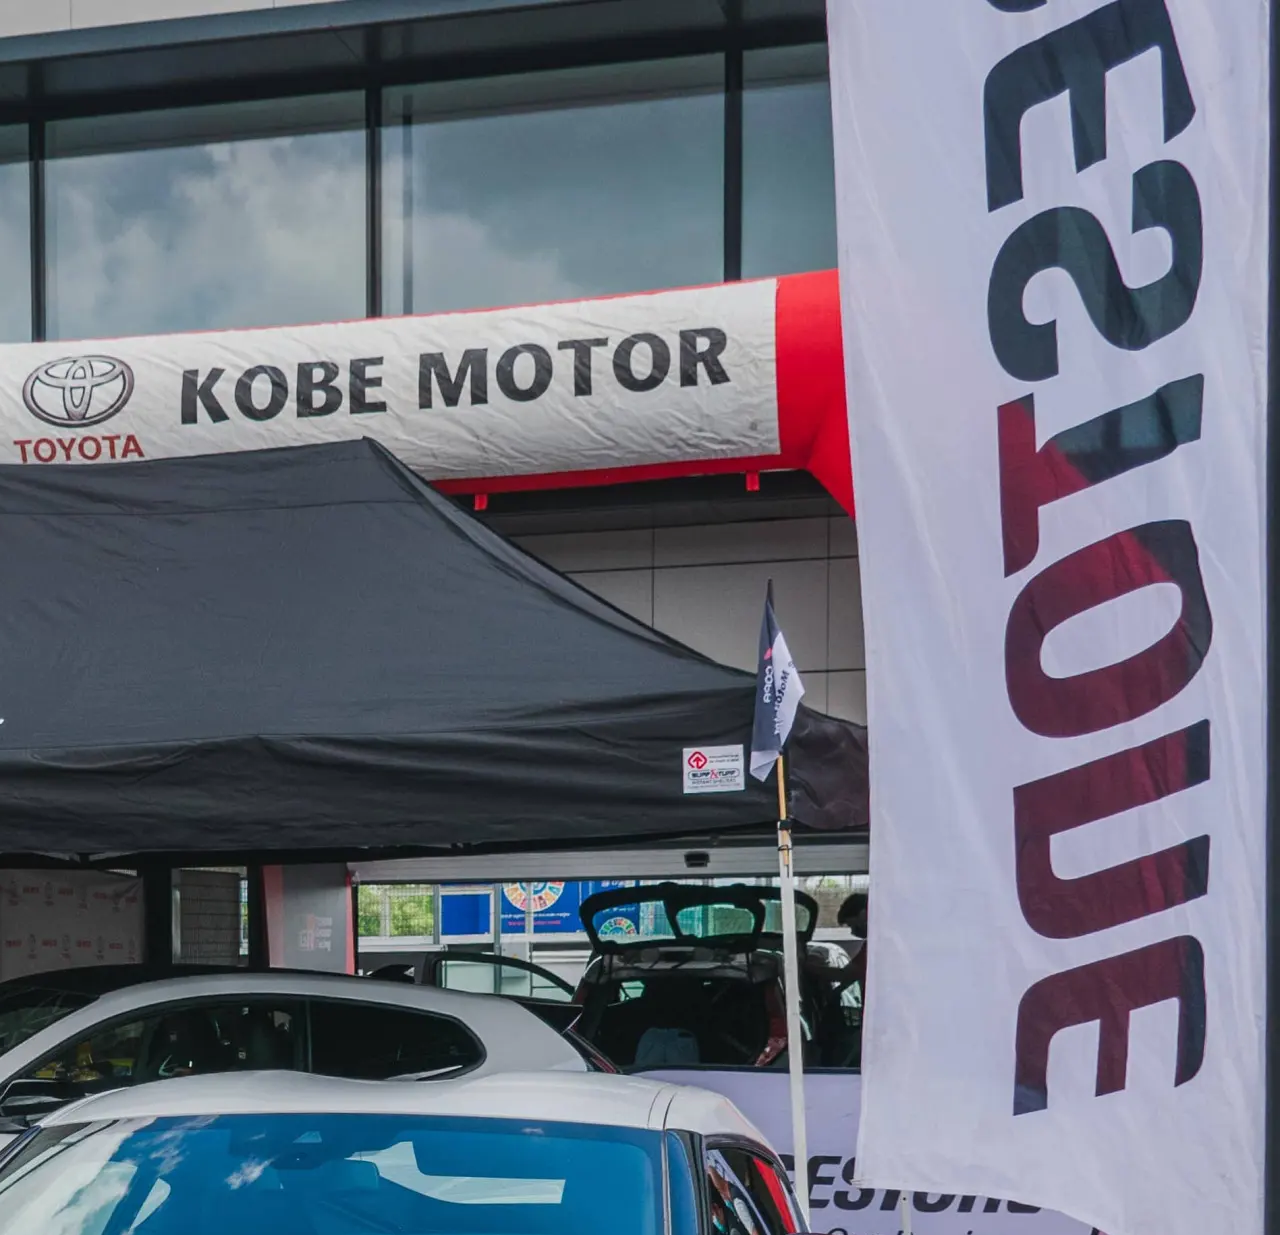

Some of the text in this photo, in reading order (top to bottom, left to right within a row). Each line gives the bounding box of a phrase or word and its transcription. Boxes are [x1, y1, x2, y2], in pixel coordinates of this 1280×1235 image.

[180, 326, 732, 425] KOBE MOTOR
[13, 434, 145, 464] TOYOTA
